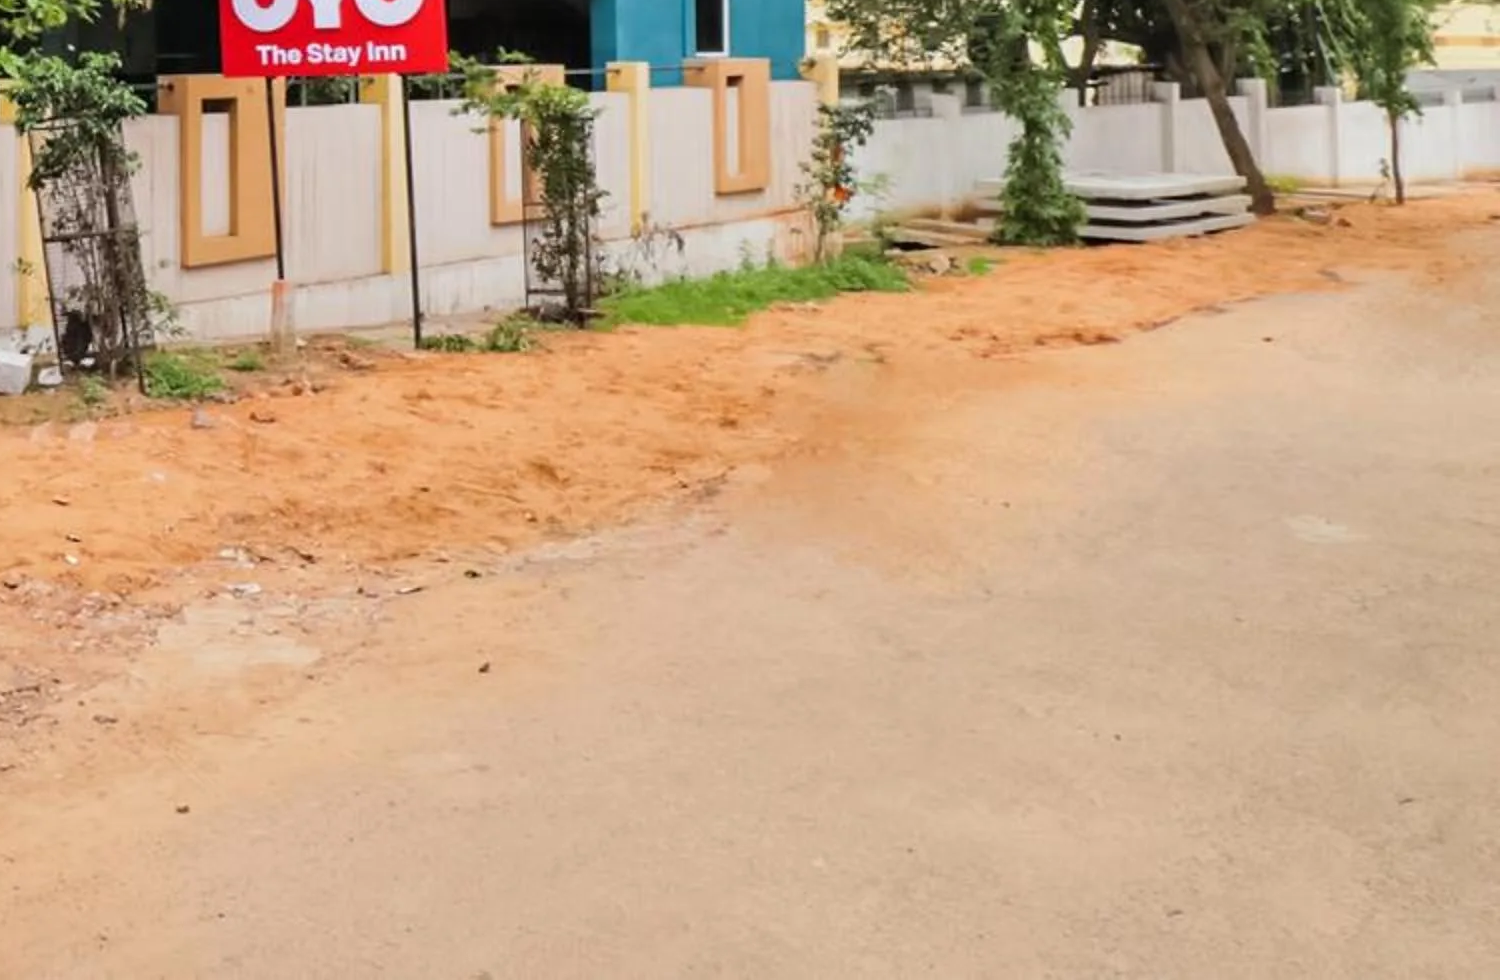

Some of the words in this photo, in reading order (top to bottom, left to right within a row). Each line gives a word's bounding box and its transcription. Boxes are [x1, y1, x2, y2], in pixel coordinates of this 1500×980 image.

[256, 44, 303, 66] The
[306, 42, 362, 67] Stay
[367, 40, 407, 62] Inn
